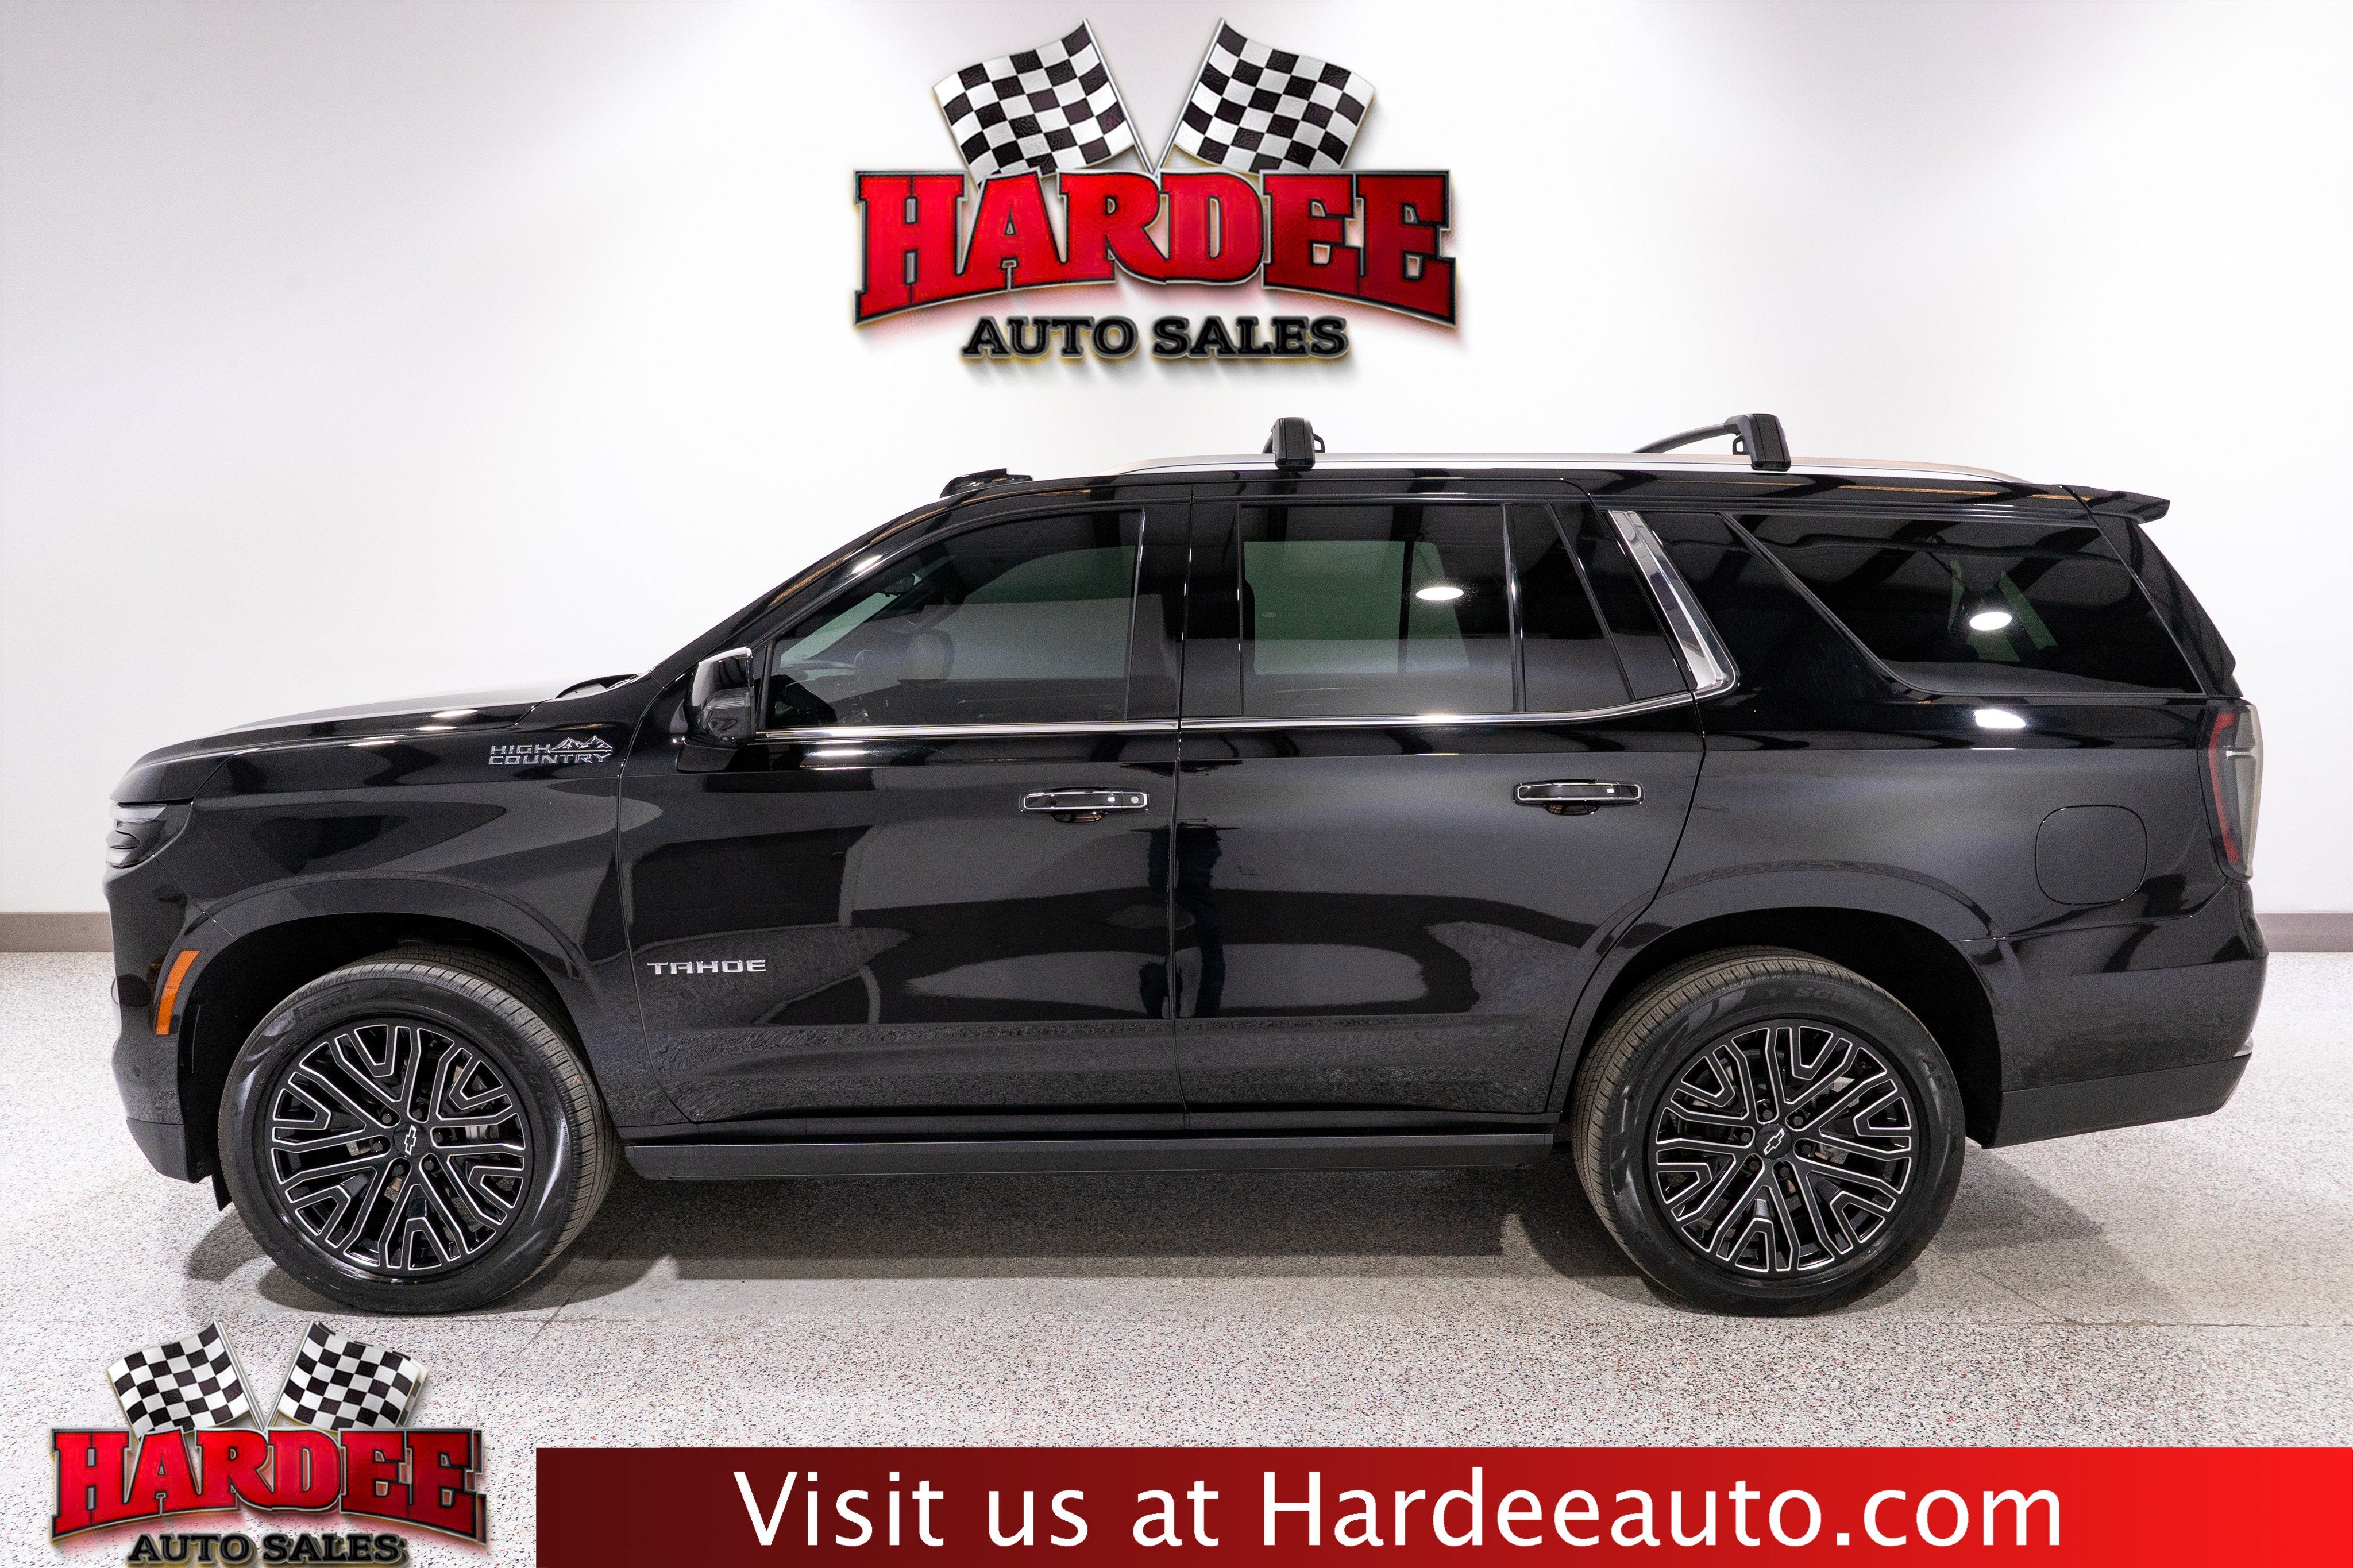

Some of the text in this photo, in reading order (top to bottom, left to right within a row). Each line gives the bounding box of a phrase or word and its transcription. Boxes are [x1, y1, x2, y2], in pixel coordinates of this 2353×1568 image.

[854, 168, 1456, 326] HARDEE
[961, 316, 1350, 358] AUTO SALES
[490, 744, 550, 754] HIGH
[488, 754, 611, 765] COUNTRY
[647, 959, 766, 975] TAHOE
